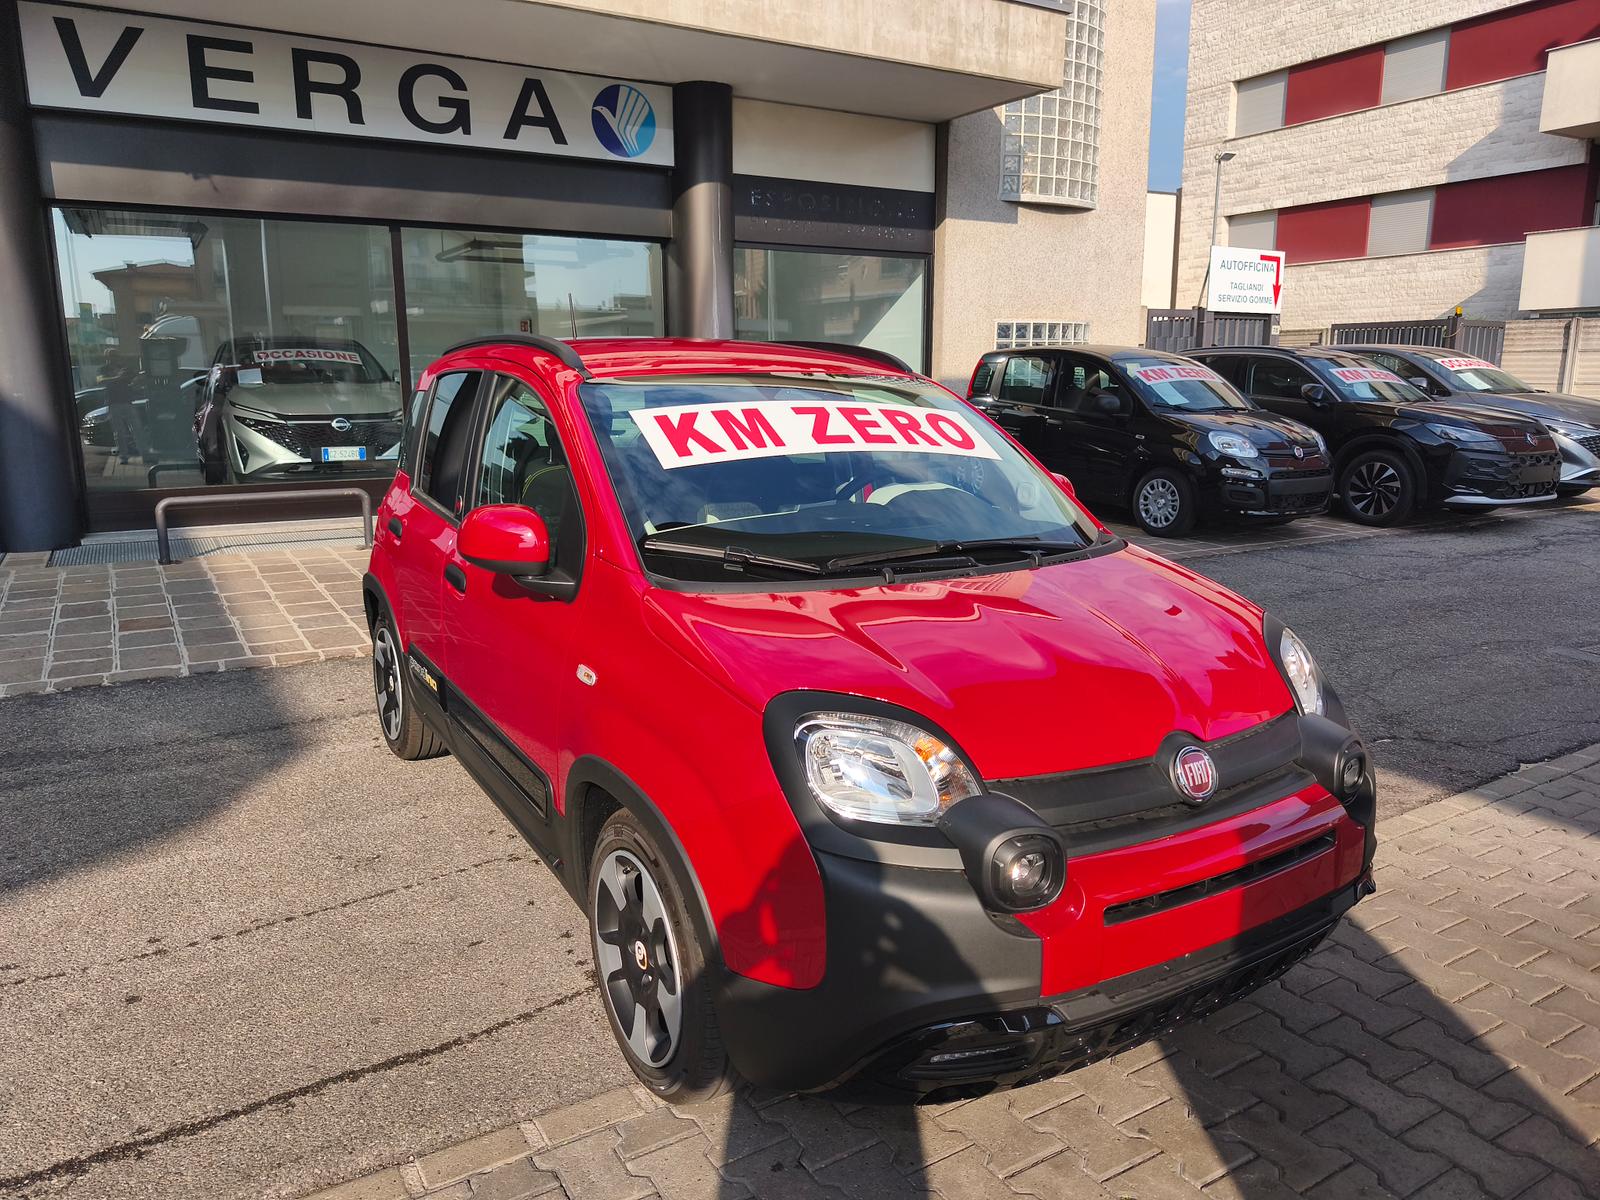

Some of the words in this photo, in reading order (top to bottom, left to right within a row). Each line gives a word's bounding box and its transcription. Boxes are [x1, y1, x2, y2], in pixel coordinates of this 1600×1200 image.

[52, 16, 568, 145] VERGA
[1219, 259, 1275, 273] AUTOFFICINA
[1230, 281, 1264, 292] TAGLIANDI
[1217, 294, 1248, 304] SERVIZIO
[1248, 296, 1273, 305] GOMME
[256, 350, 360, 362] OCCASIONE
[1136, 367, 1174, 382] KM
[1336, 369, 1368, 382] KM
[653, 408, 786, 458] KM
[791, 406, 976, 451] ZERO
[1184, 759, 1209, 787] FIAT
